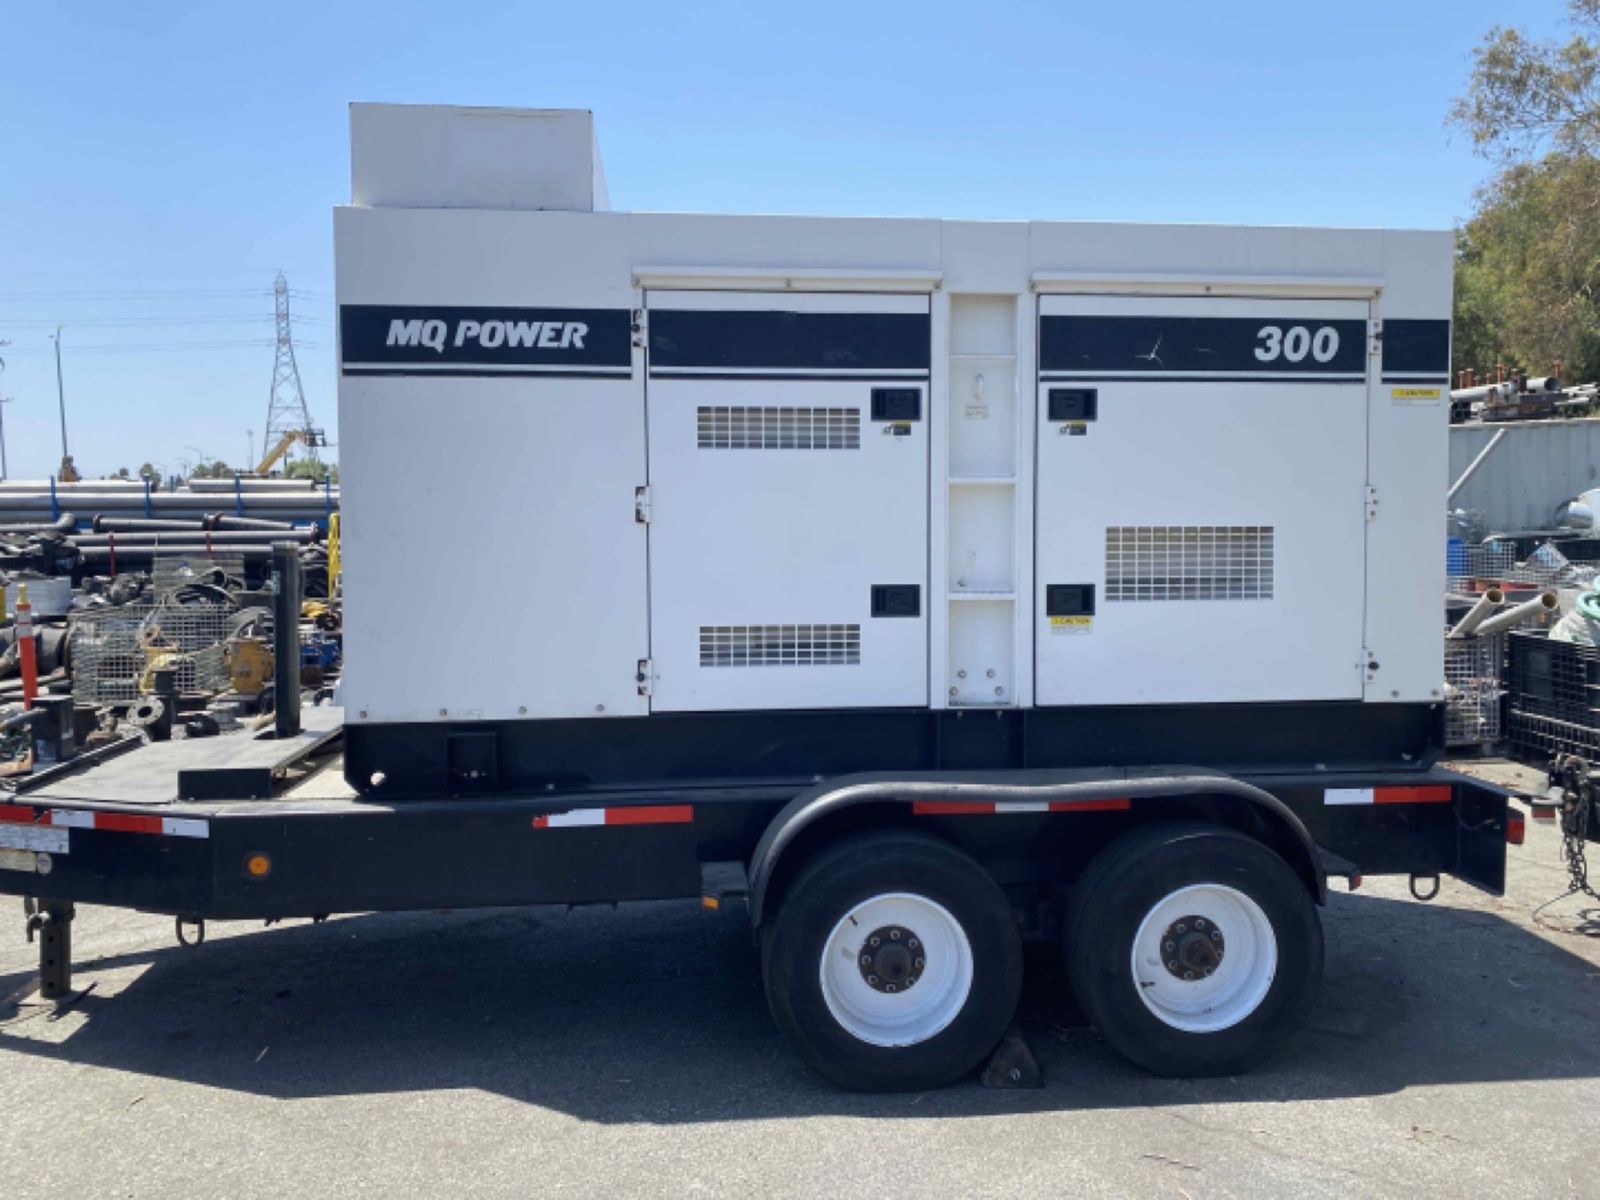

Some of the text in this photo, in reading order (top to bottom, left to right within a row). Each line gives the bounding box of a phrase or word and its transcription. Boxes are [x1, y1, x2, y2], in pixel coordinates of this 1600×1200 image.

[386, 319, 589, 353] MQ POWER
[1254, 326, 1340, 363] 300
